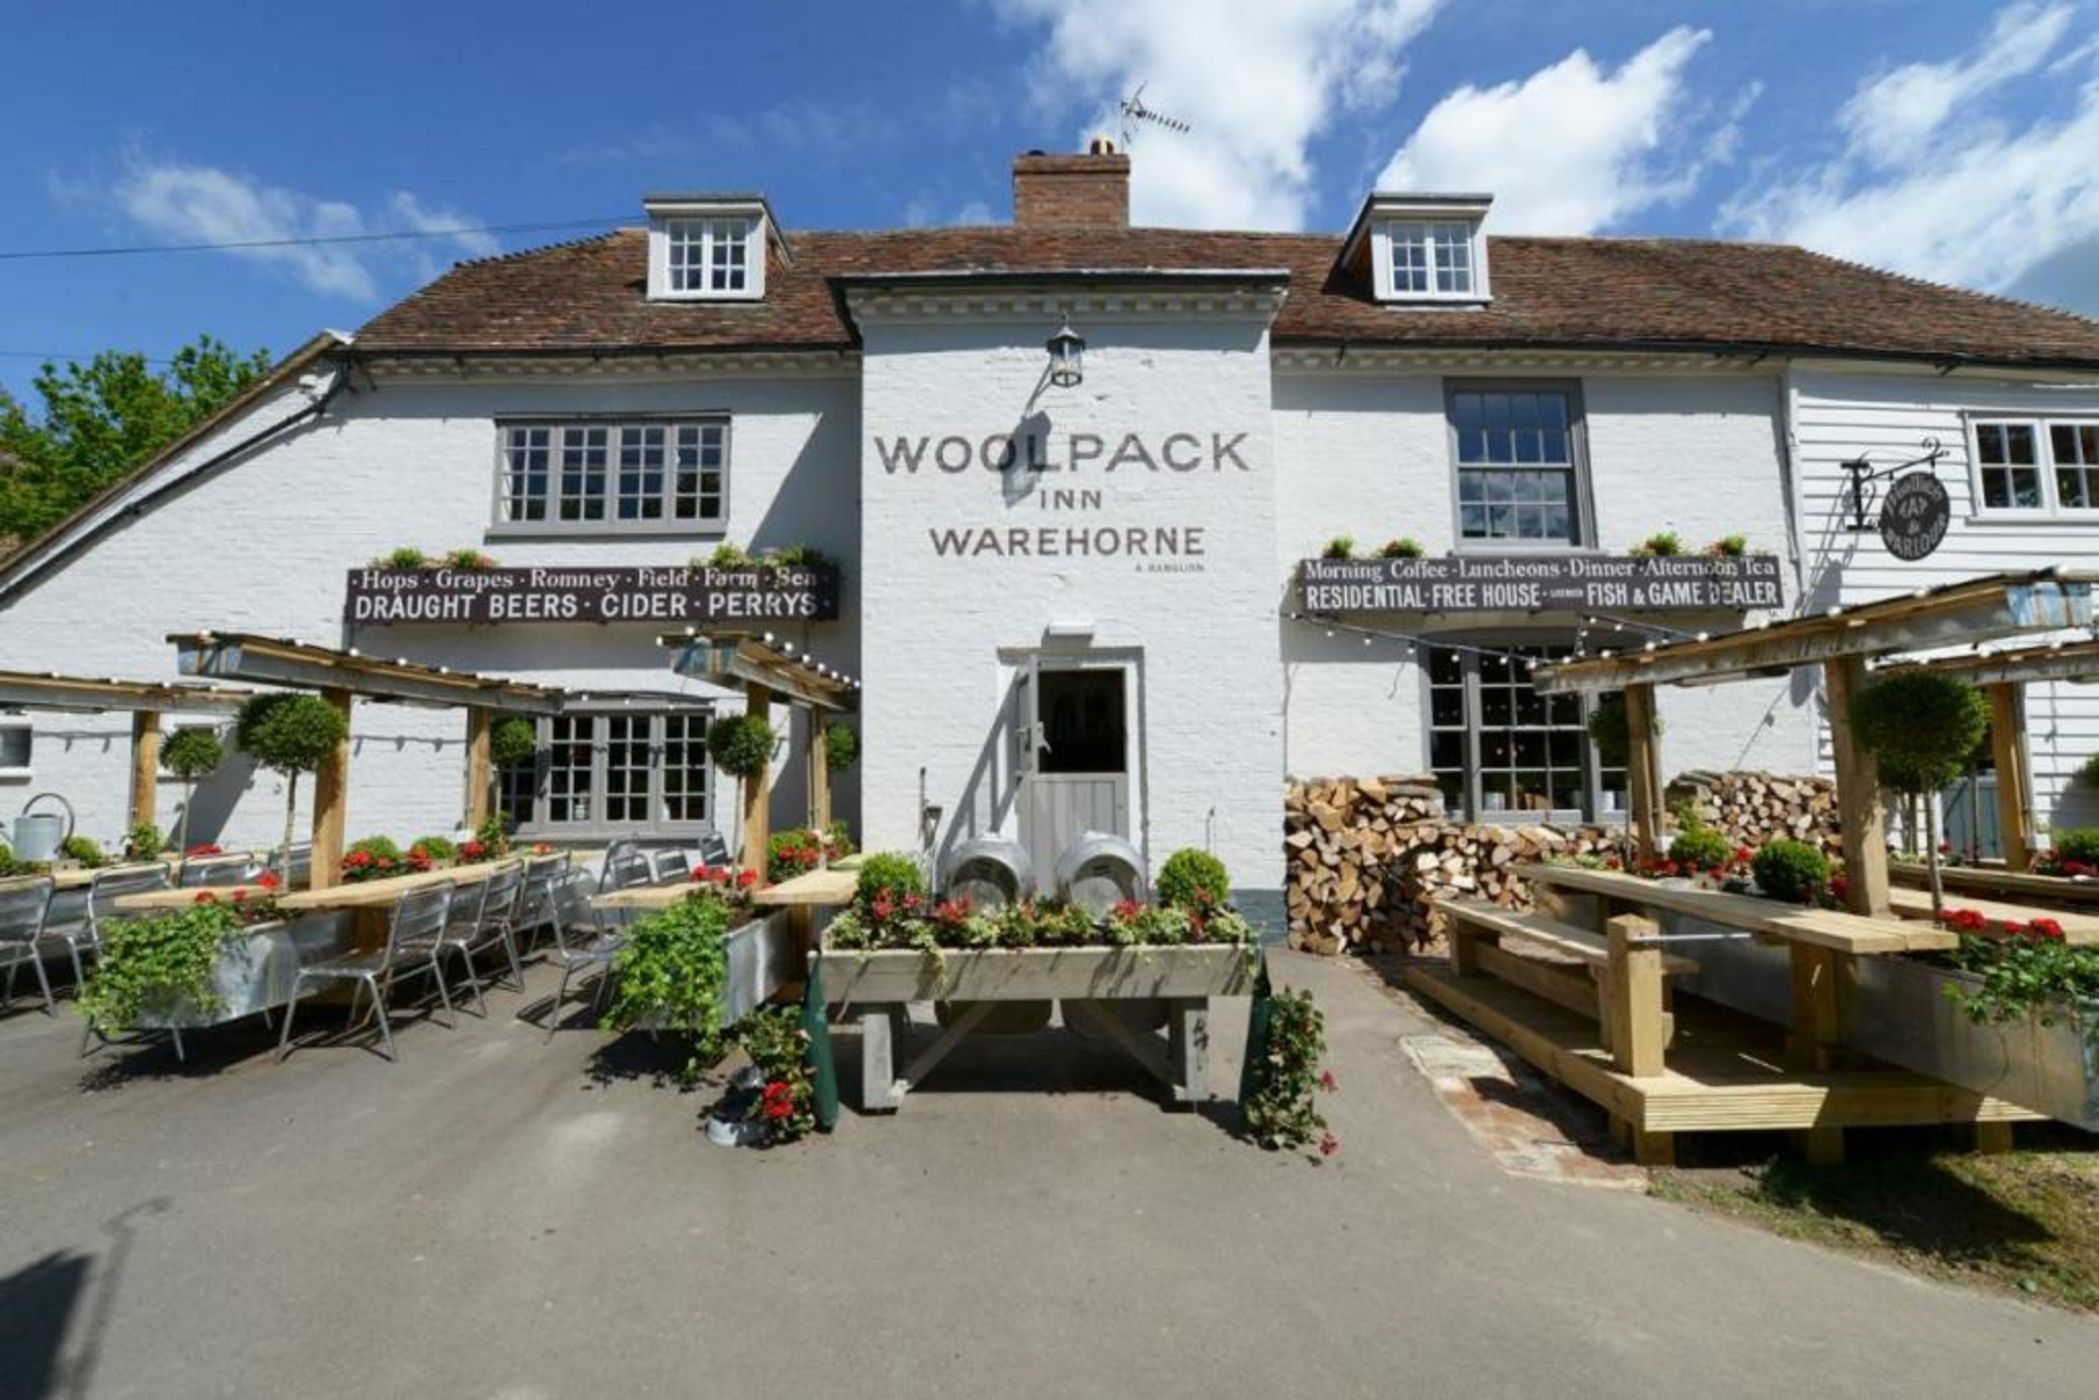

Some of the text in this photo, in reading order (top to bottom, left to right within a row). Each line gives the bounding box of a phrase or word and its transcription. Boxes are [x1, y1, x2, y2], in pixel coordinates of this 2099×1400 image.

[874, 432, 1251, 475] WOOLPACK
[1040, 489, 1102, 510] INN
[929, 527, 1204, 557] WAREHORNE
[361, 569, 418, 589] Hops
[436, 569, 513, 589] Grapes
[530, 569, 620, 591] Romney
[637, 567, 689, 587] Field
[1306, 557, 1775, 582] Morning Coffee Luncheons Dinner Afternoon Tea
[356, 592, 817, 619] DRAUGHT BEERS CIDER PERRYS
[1306, 580, 1778, 610] RESIDENTIAL FREE HOUSE FISH & GAME DEALER
